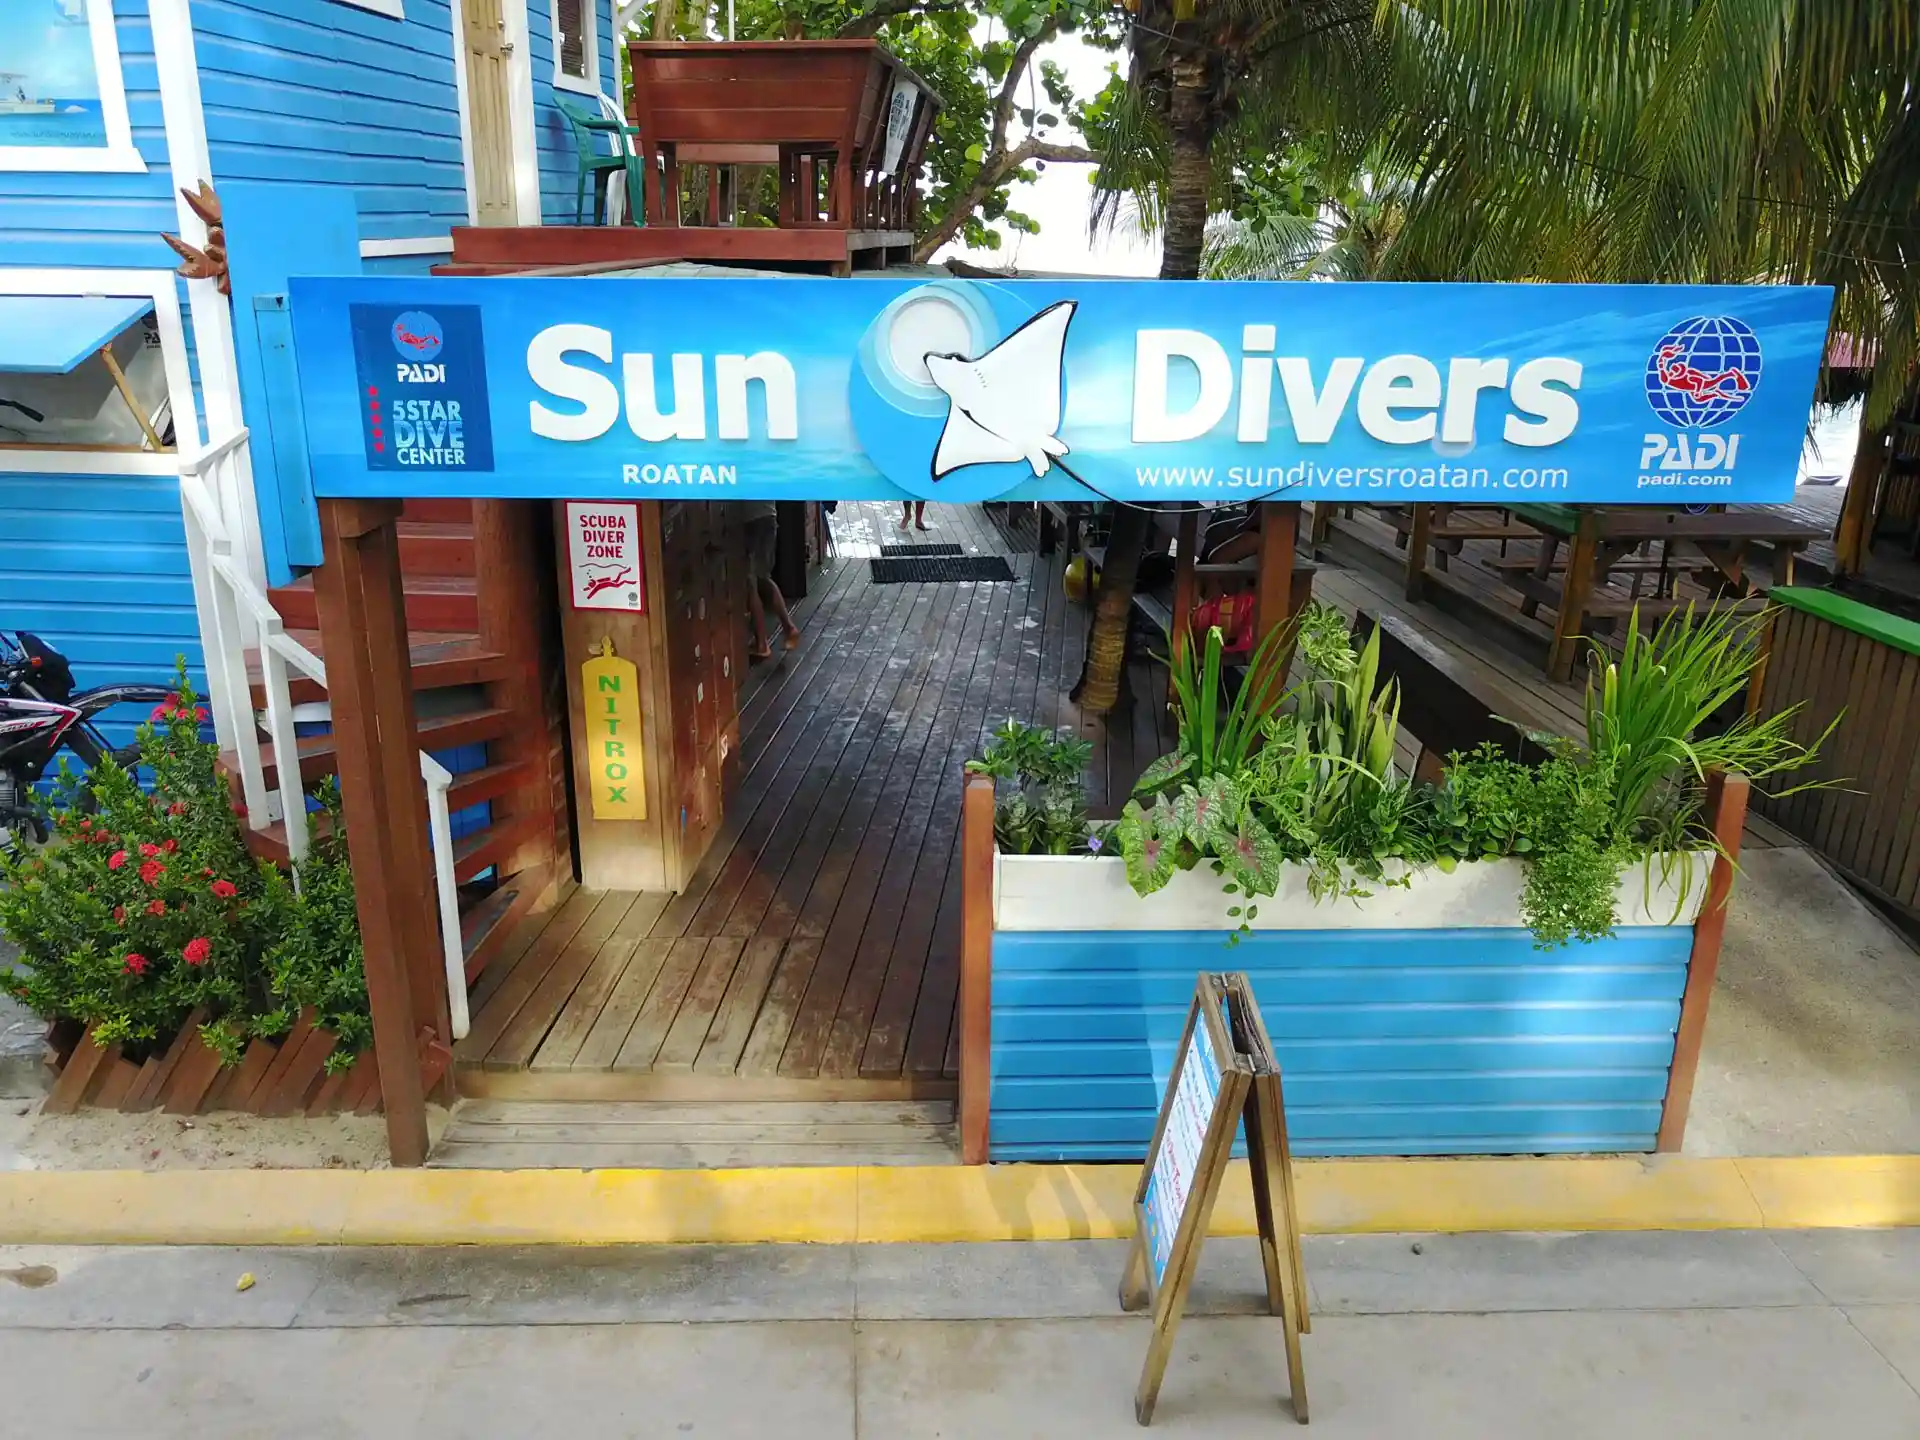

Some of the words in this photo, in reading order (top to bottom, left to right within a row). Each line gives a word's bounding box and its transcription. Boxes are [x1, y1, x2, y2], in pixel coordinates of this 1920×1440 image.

[396, 363, 446, 383] PADI
[527, 324, 798, 442] Sun
[1131, 324, 1583, 447] Divers
[393, 420, 465, 448] DIVE
[396, 448, 466, 465] CENTER
[1639, 433, 1740, 470] PADI
[622, 463, 737, 485] ROATAN
[1135, 461, 1570, 489] www.sundiversroatan.com
[1637, 472, 1733, 488] padi.com
[579, 514, 627, 529] SCUBA
[582, 530, 625, 544] DIVER
[586, 545, 624, 559] ZONE
[598, 675, 628, 803] NITROX
